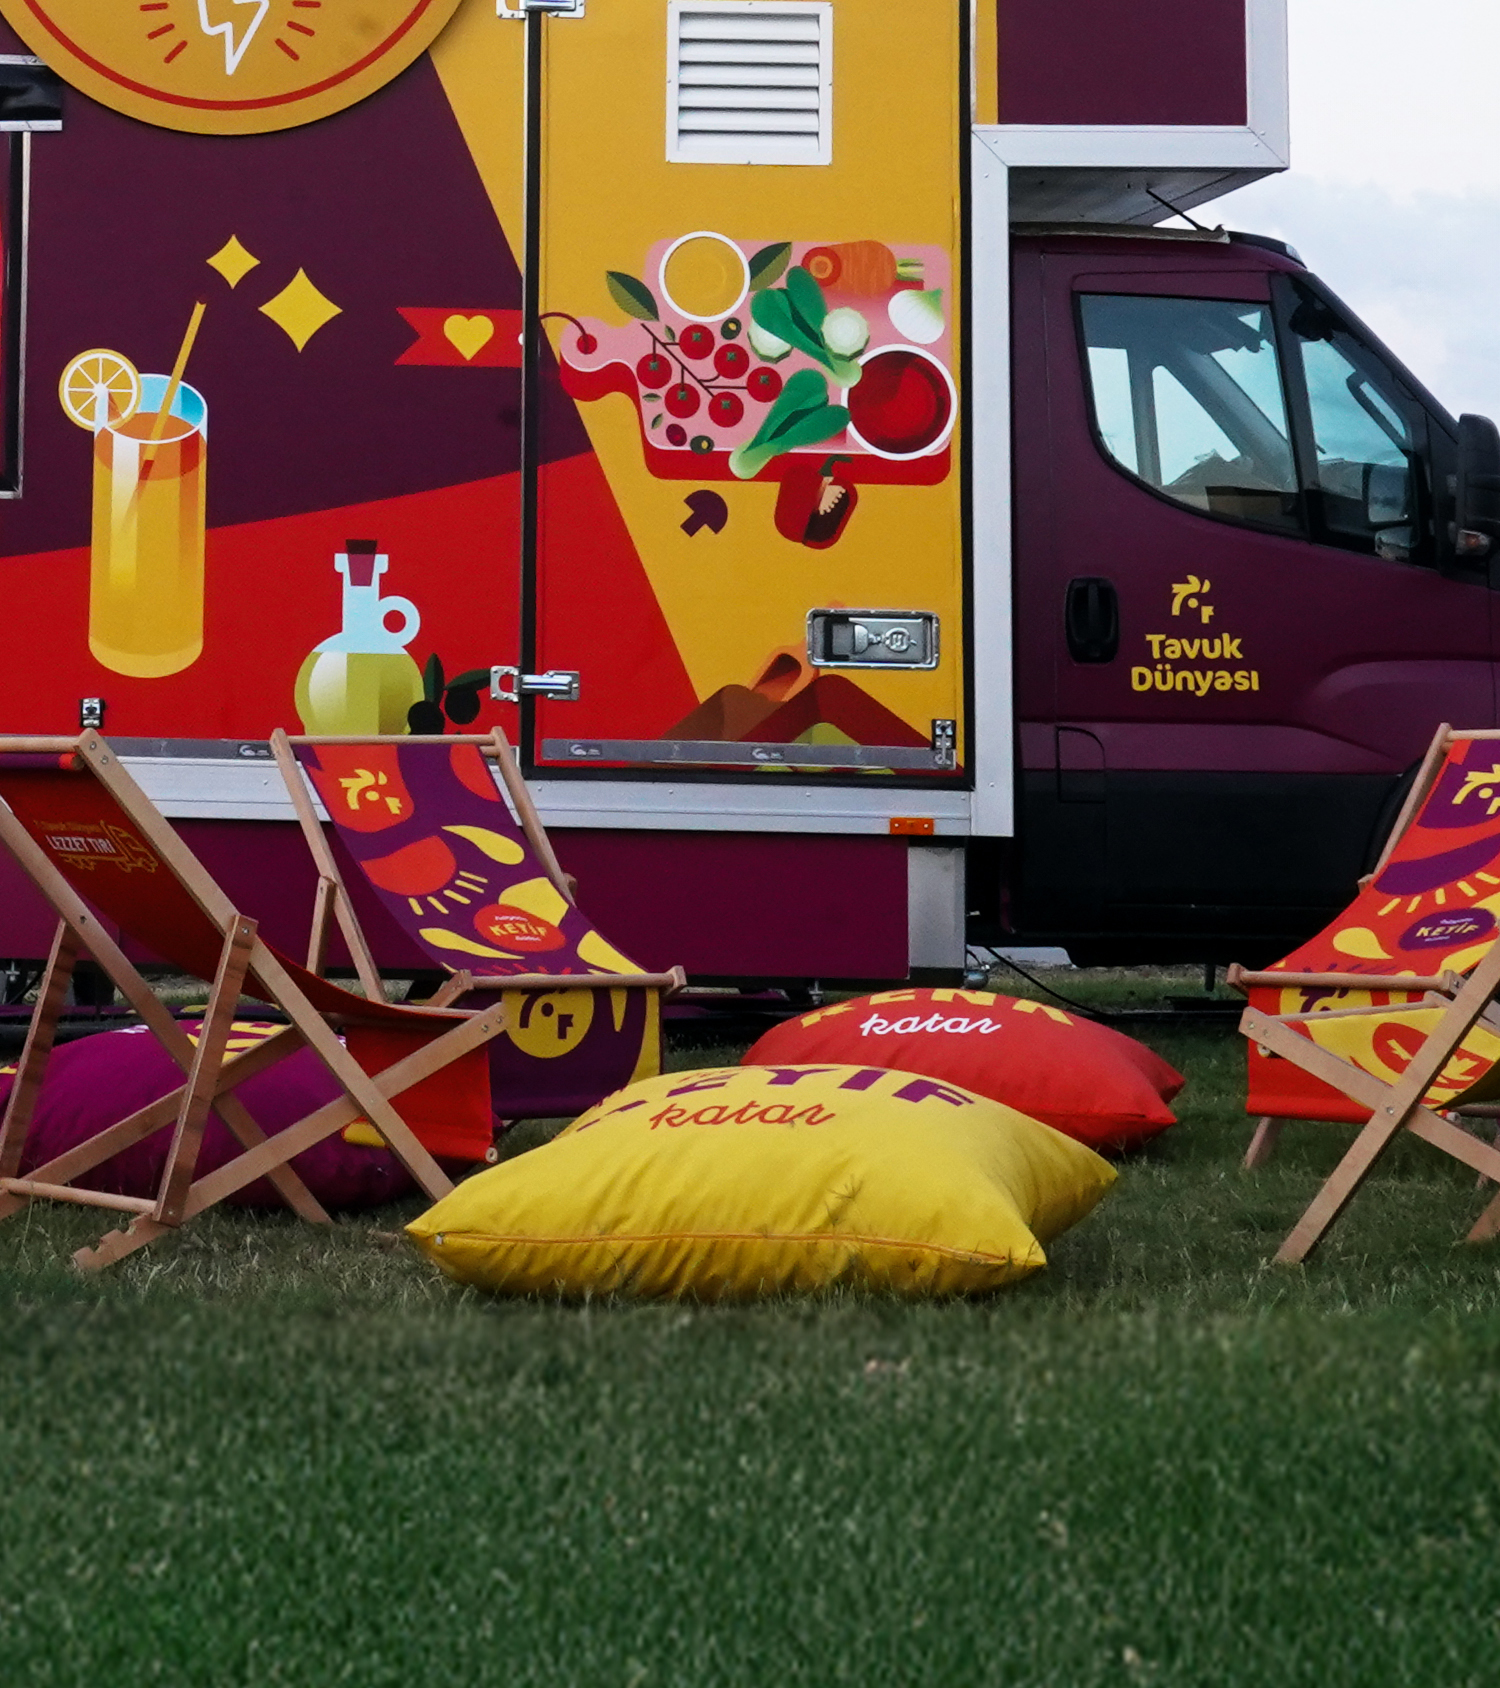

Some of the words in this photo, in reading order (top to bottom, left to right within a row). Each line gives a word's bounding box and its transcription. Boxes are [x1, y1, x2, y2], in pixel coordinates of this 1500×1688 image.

[1145, 632, 1243, 661] Tavuk
[1130, 662, 1260, 697] Dünyası
[859, 1013, 1002, 1037] katar
[650, 1100, 837, 1131] katar
